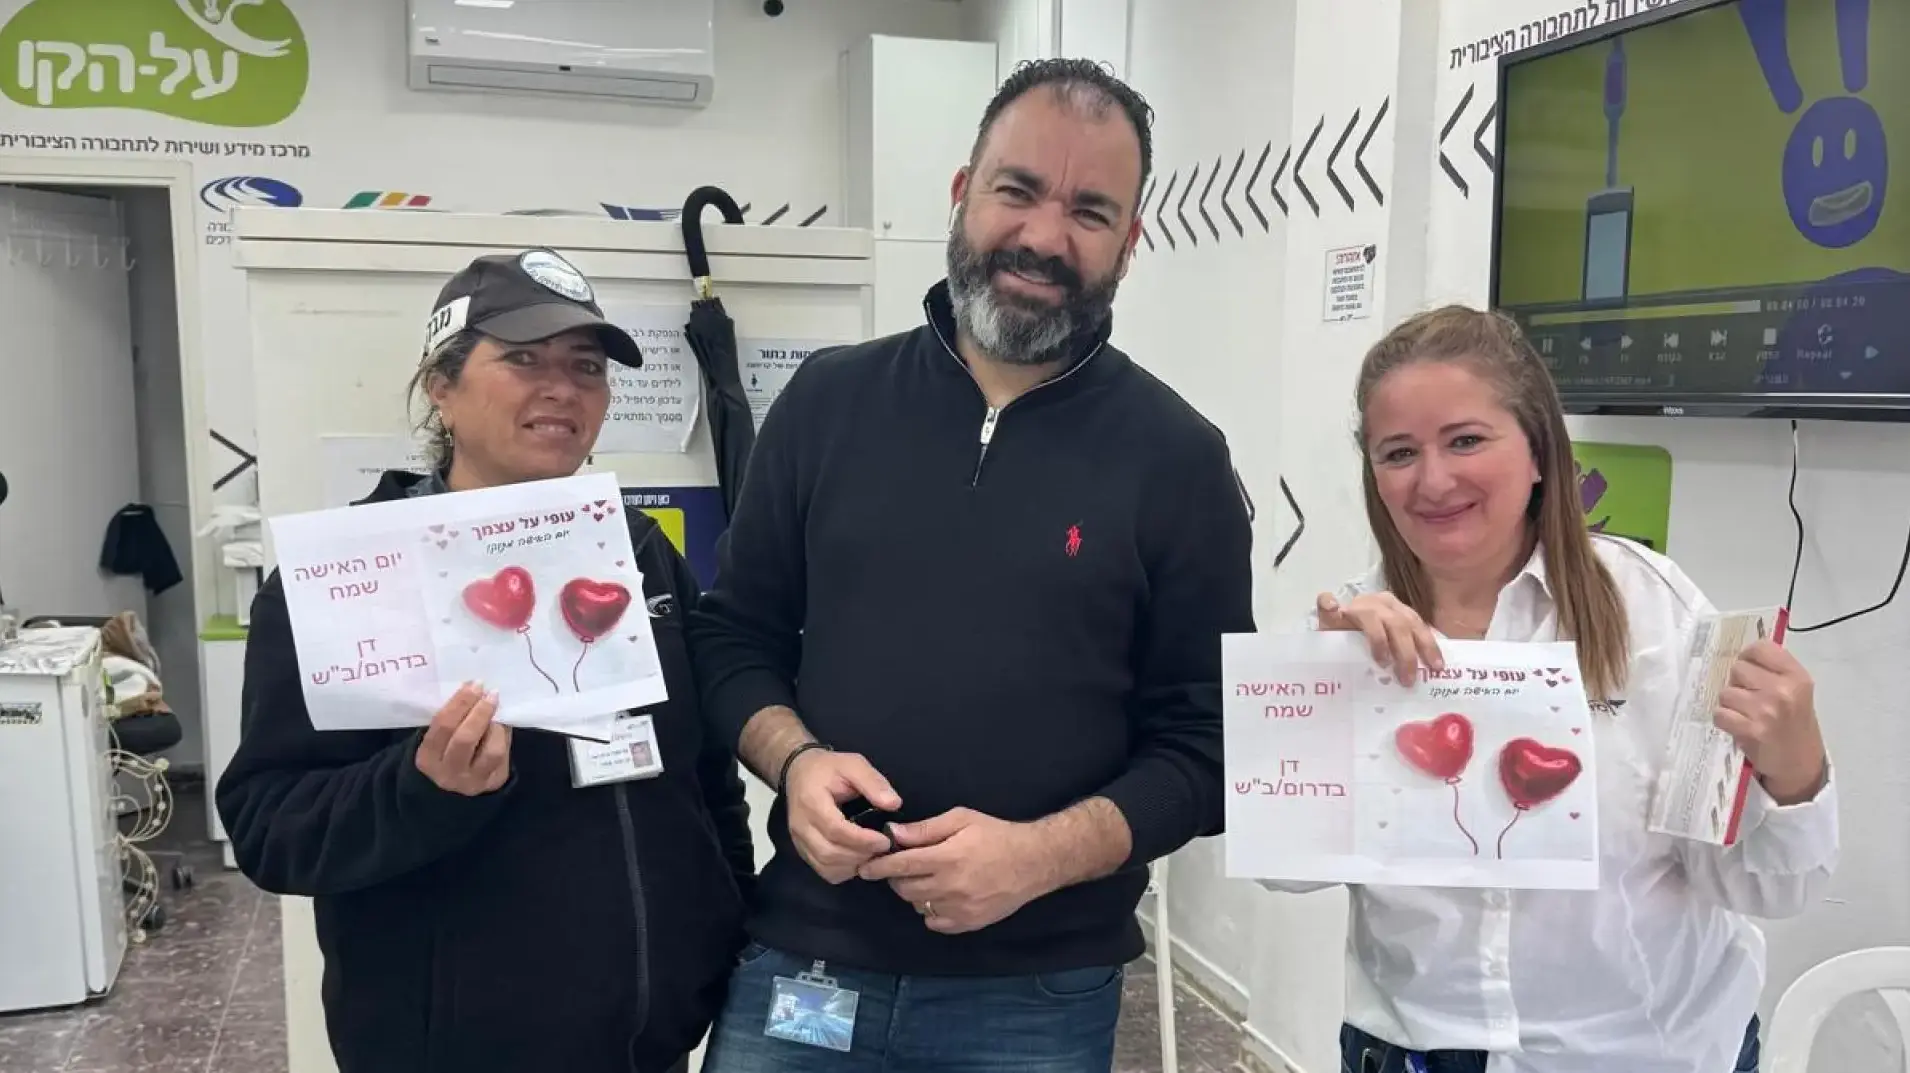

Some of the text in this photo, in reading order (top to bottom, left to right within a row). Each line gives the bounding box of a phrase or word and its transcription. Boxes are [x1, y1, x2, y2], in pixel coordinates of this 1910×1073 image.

[1520, 0, 1600, 48] לתחבורה
[1450, 29, 1516, 69] הציבורית
[18, 31, 239, 105] על-הקו
[0, 133, 311, 158] מרכז מידע ושירות לתחבורה הציבורית
[471, 510, 576, 541] עופי על עצמך
[294, 551, 402, 582] יום האישה
[329, 579, 379, 600] שמח
[357, 638, 377, 659] דן
[312, 654, 428, 685] בדרום/ב"ש
[1466, 667, 1488, 680] על
[1493, 669, 1526, 682] עופי
[1236, 681, 1342, 697] יום האישה
[1265, 704, 1313, 718] שמח
[1280, 759, 1300, 777] דן
[1235, 778, 1347, 797] בדרום/ב"ש
